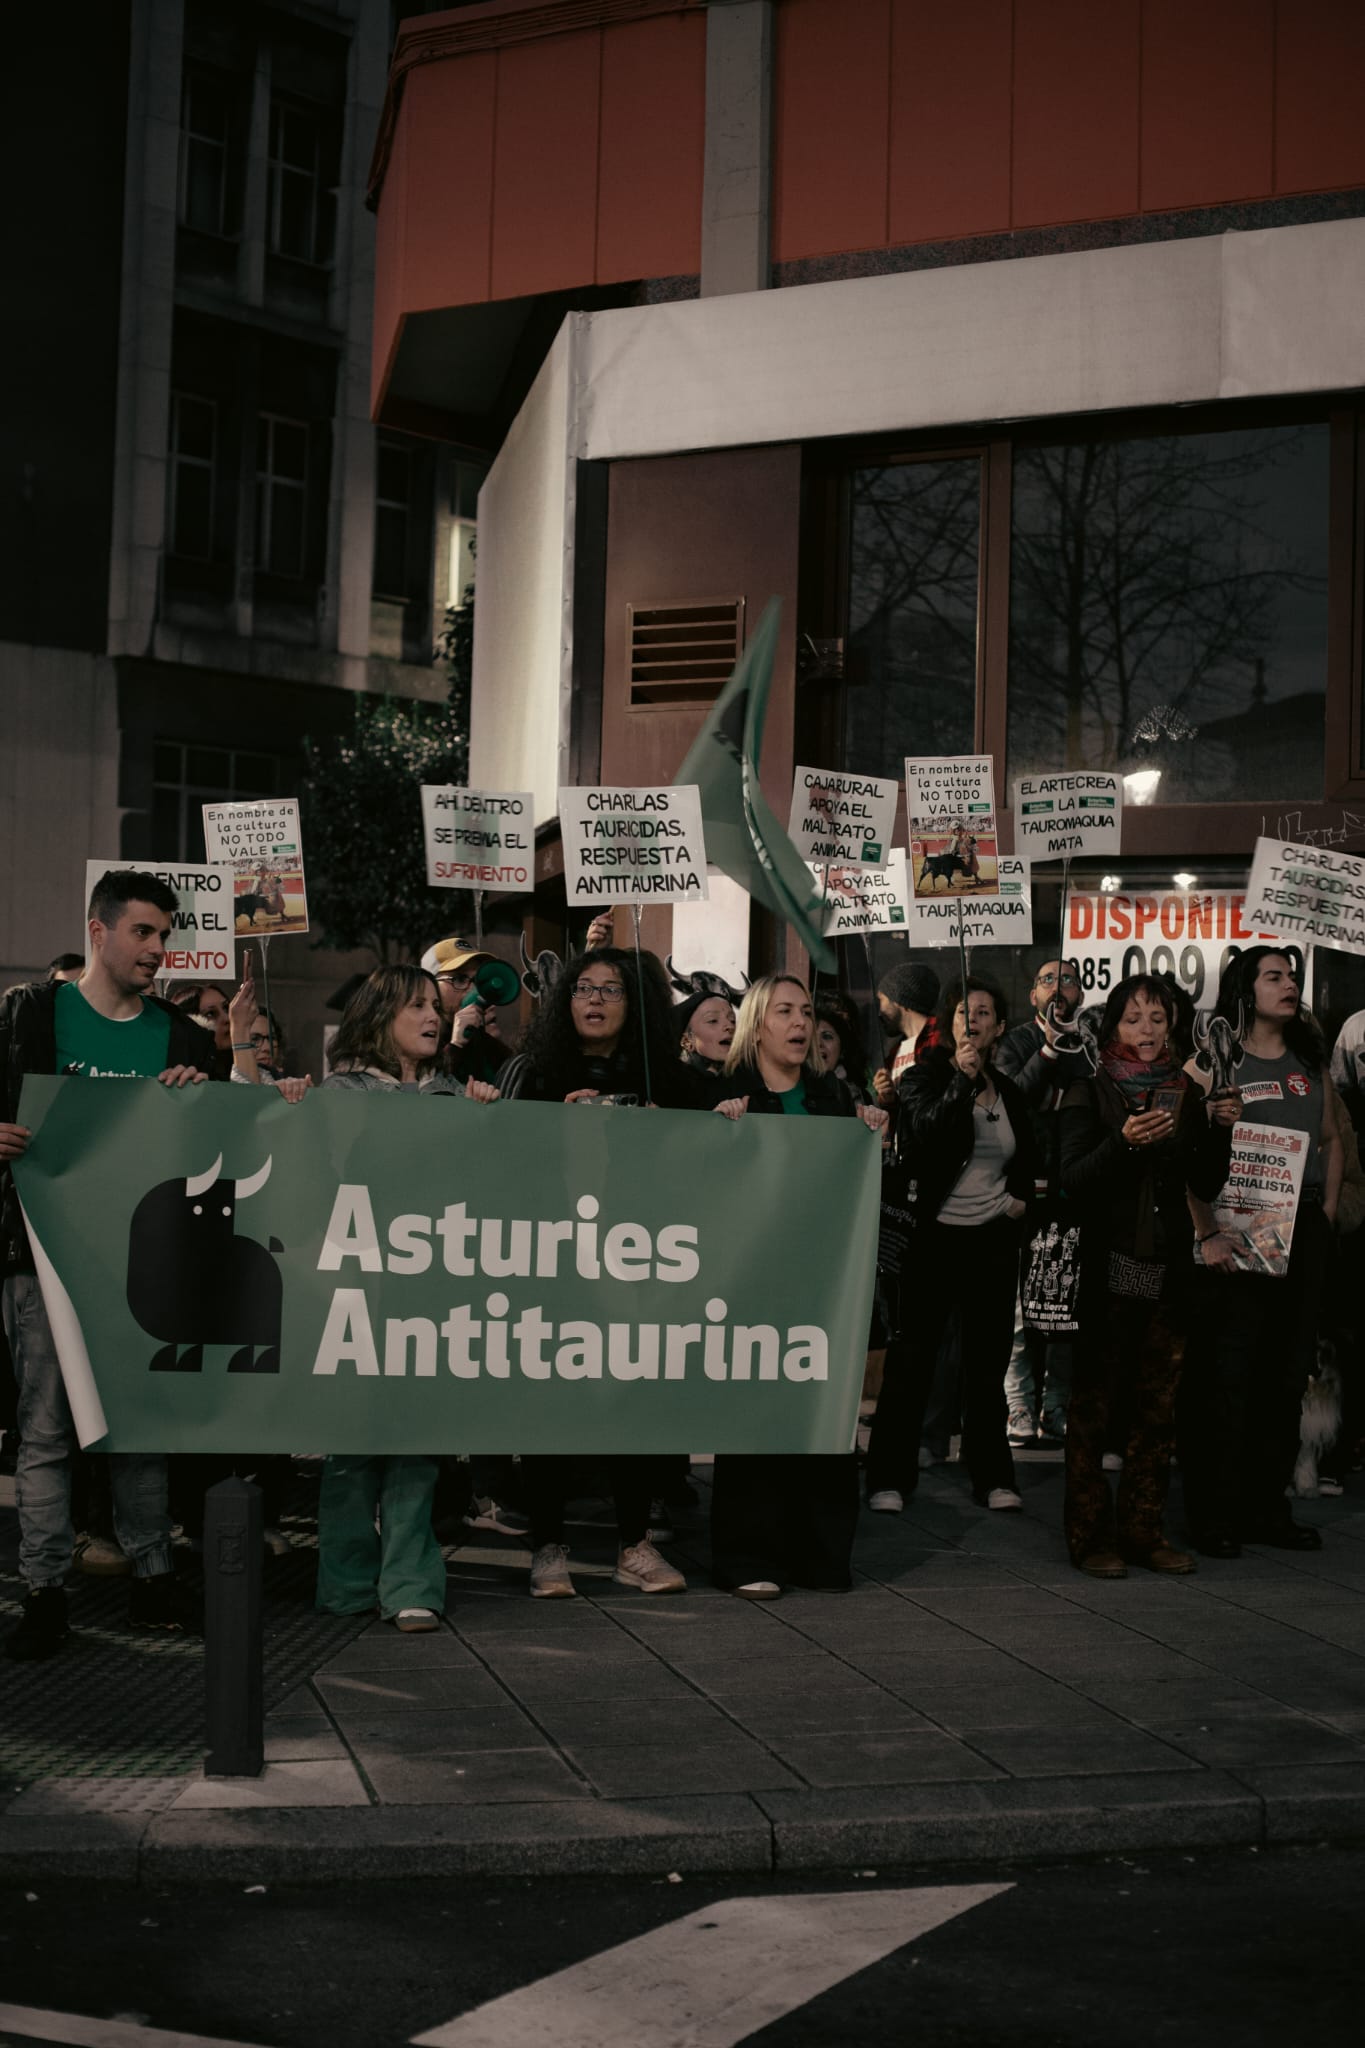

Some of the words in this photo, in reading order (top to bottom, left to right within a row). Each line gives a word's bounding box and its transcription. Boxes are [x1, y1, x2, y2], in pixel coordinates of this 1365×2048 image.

[910, 765, 924, 774] En
[929, 764, 971, 774] nombre
[975, 763, 988, 773] de
[918, 778, 930, 788] la
[935, 777, 981, 787] cultura
[587, 793, 669, 812] CHARLAS
[920, 791, 940, 801] NO
[945, 790, 980, 801] TODO
[463, 796, 524, 815] DENTRO
[928, 804, 964, 814] VALE
[1058, 798, 1075, 811] LA
[208, 811, 224, 821] En
[228, 809, 275, 819] nombre
[279, 807, 294, 816] de
[217, 823, 231, 832] la
[235, 821, 286, 831] cultura
[802, 818, 876, 840] MALTRATO
[1020, 815, 1115, 834] TAUROMAQUIA
[220, 834, 241, 845] NO
[246, 831, 285, 843] TODO
[504, 833, 528, 849] EL
[1048, 835, 1083, 852] MATA
[229, 845, 268, 857] VALE
[580, 846, 691, 866] RESPUESTA
[810, 842, 857, 859] ANIMAL
[1281, 847, 1362, 877] CHARLAS
[575, 872, 700, 894] ANTITAURINA
[916, 902, 1025, 918] TAUROMAQUIA
[1261, 887, 1365, 923] RESPUESTA
[202, 913, 228, 931] EL
[837, 913, 888, 928] ANIMAL
[1251, 908, 1365, 945] ANTITAURINA
[949, 923, 994, 938] MATA
[1229, 1162, 1293, 1181] GUERRA
[1229, 1176, 1295, 1195] ERIALISTA
[316, 1183, 700, 1283] Asturies
[312, 1287, 829, 1382] Antitaurina
